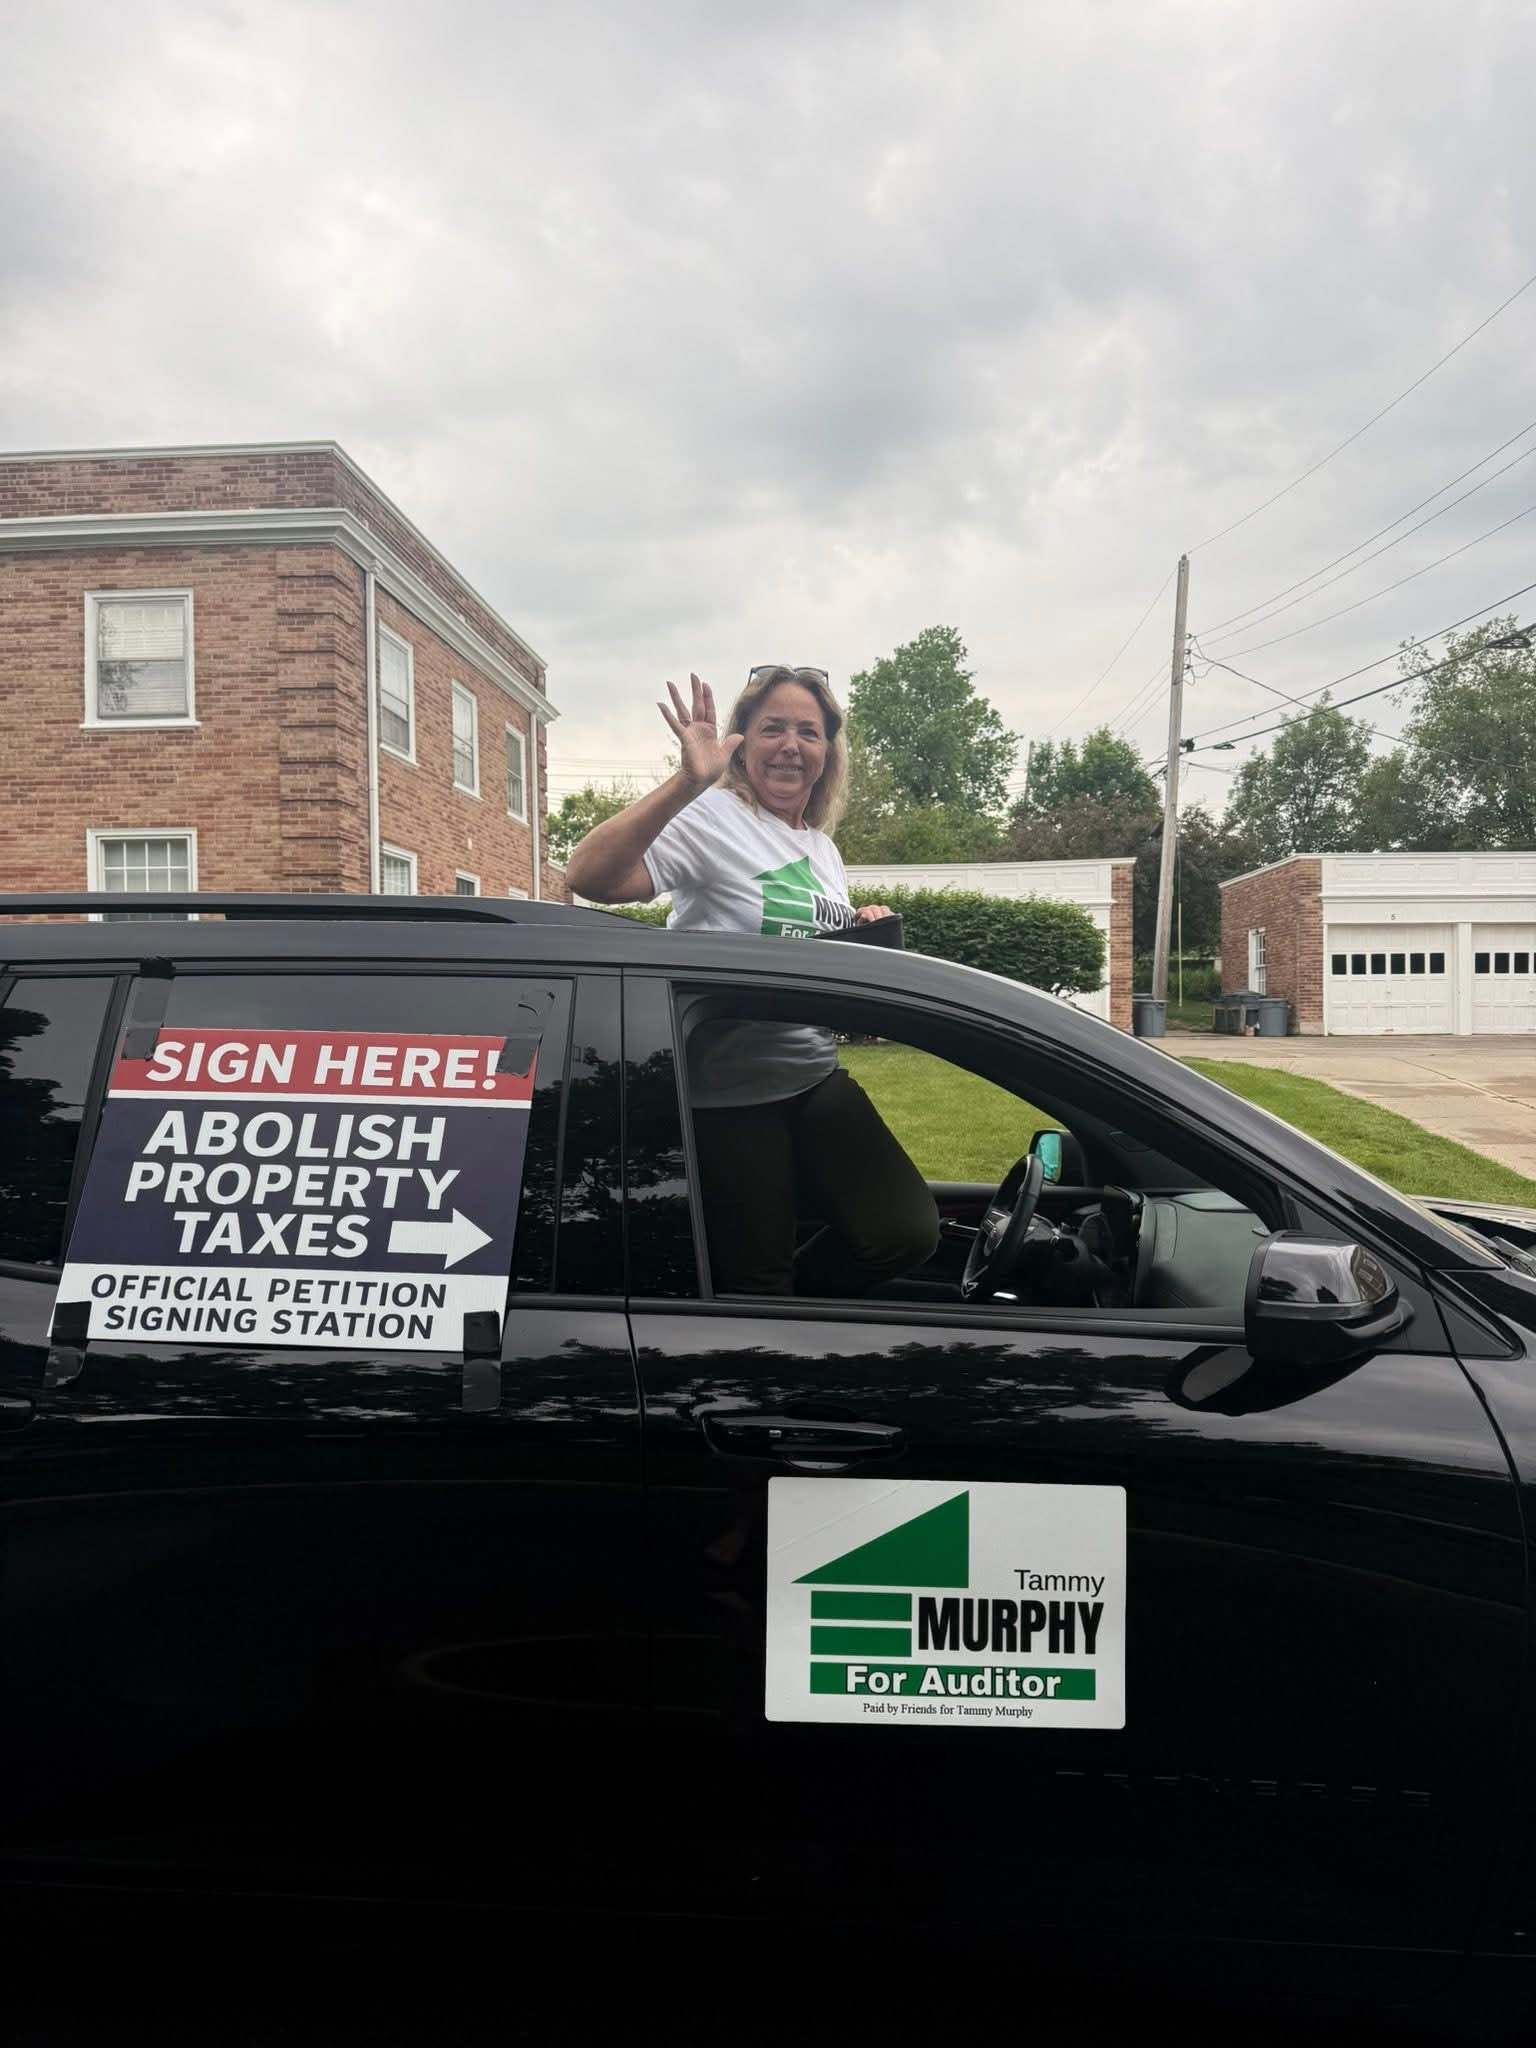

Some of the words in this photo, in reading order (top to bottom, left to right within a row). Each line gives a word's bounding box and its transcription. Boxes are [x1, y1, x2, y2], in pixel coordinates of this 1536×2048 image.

[781, 923, 809, 938] For
[145, 1041, 296, 1084] SIGN
[313, 1045, 501, 1090] HERE!
[141, 1110, 447, 1162] ABOLISH
[124, 1161, 460, 1211] PROPERTY
[173, 1211, 371, 1258] TAXES
[90, 1273, 254, 1303] OFFICIAL
[267, 1278, 448, 1309] PETITION
[103, 1305, 258, 1334] SIGNING
[270, 1309, 434, 1340] STATION
[1014, 1569, 1105, 1598] Tammy
[917, 1596, 1104, 1655] MURPHY
[846, 1664, 908, 1694] For
[918, 1666, 1062, 1699] Auditor
[863, 1703, 885, 1713] Paid
[887, 1703, 899, 1716] by
[901, 1704, 937, 1715] Friends
[939, 1704, 955, 1715] for
[956, 1705, 993, 1718] Tammy
[995, 1706, 1034, 1719] Murphy
